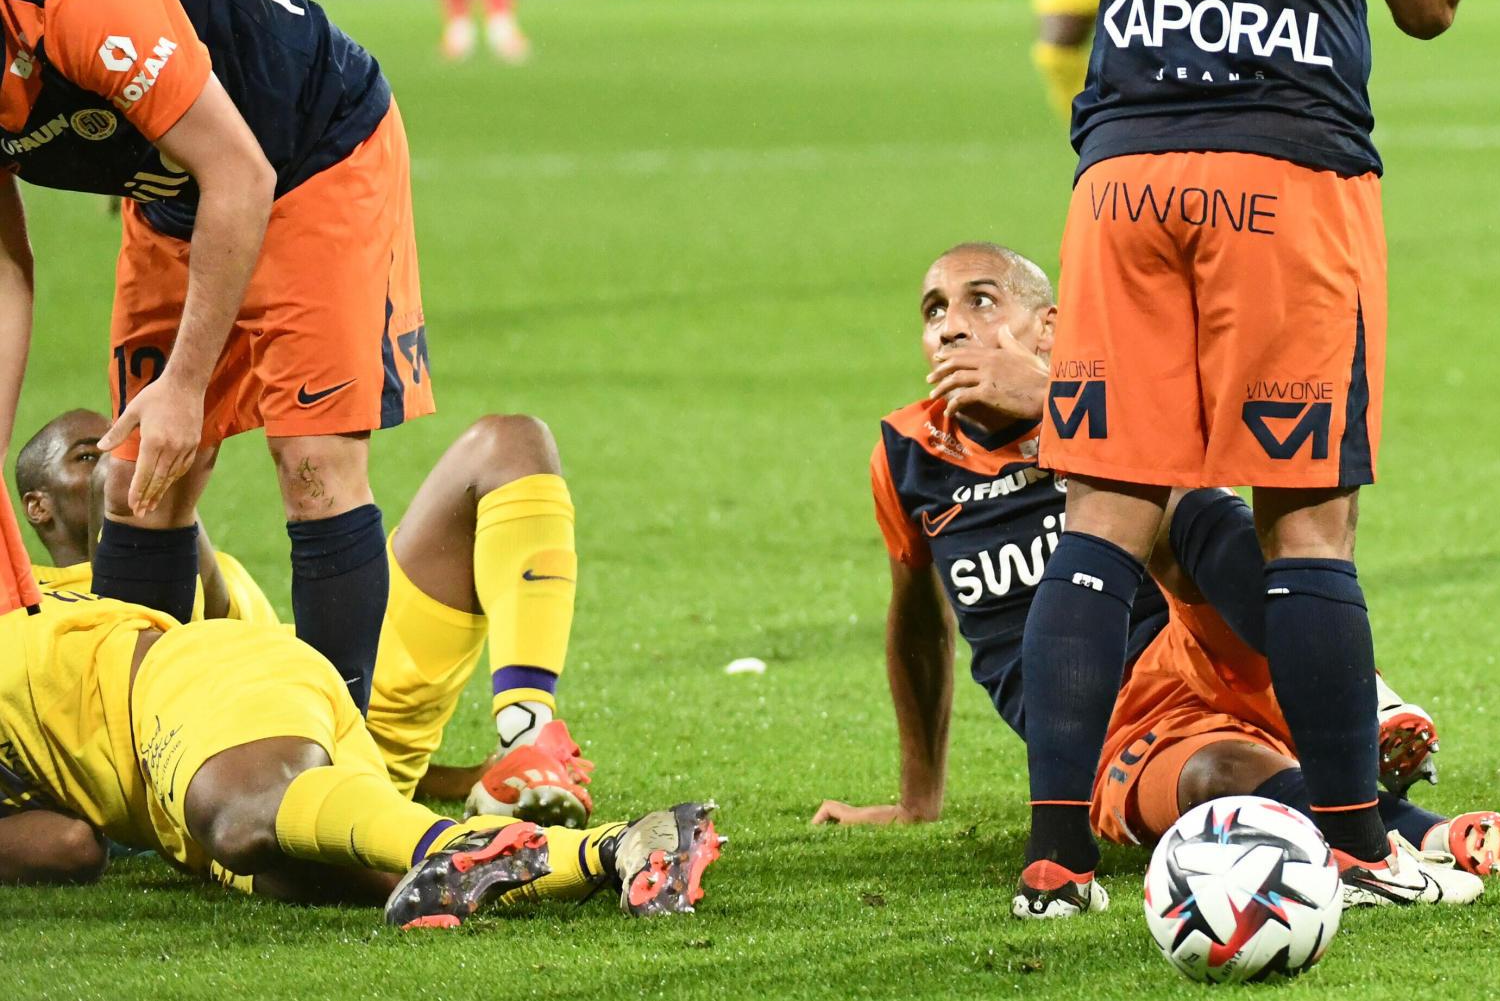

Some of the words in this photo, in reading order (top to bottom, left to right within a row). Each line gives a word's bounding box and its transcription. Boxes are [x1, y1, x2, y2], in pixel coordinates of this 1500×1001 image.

[112, 36, 178, 110] LOXAM
[1155, 66, 1265, 83] JEANS
[1091, 181, 1279, 236] VIWONE
[1246, 380, 1334, 401] VIWONE
